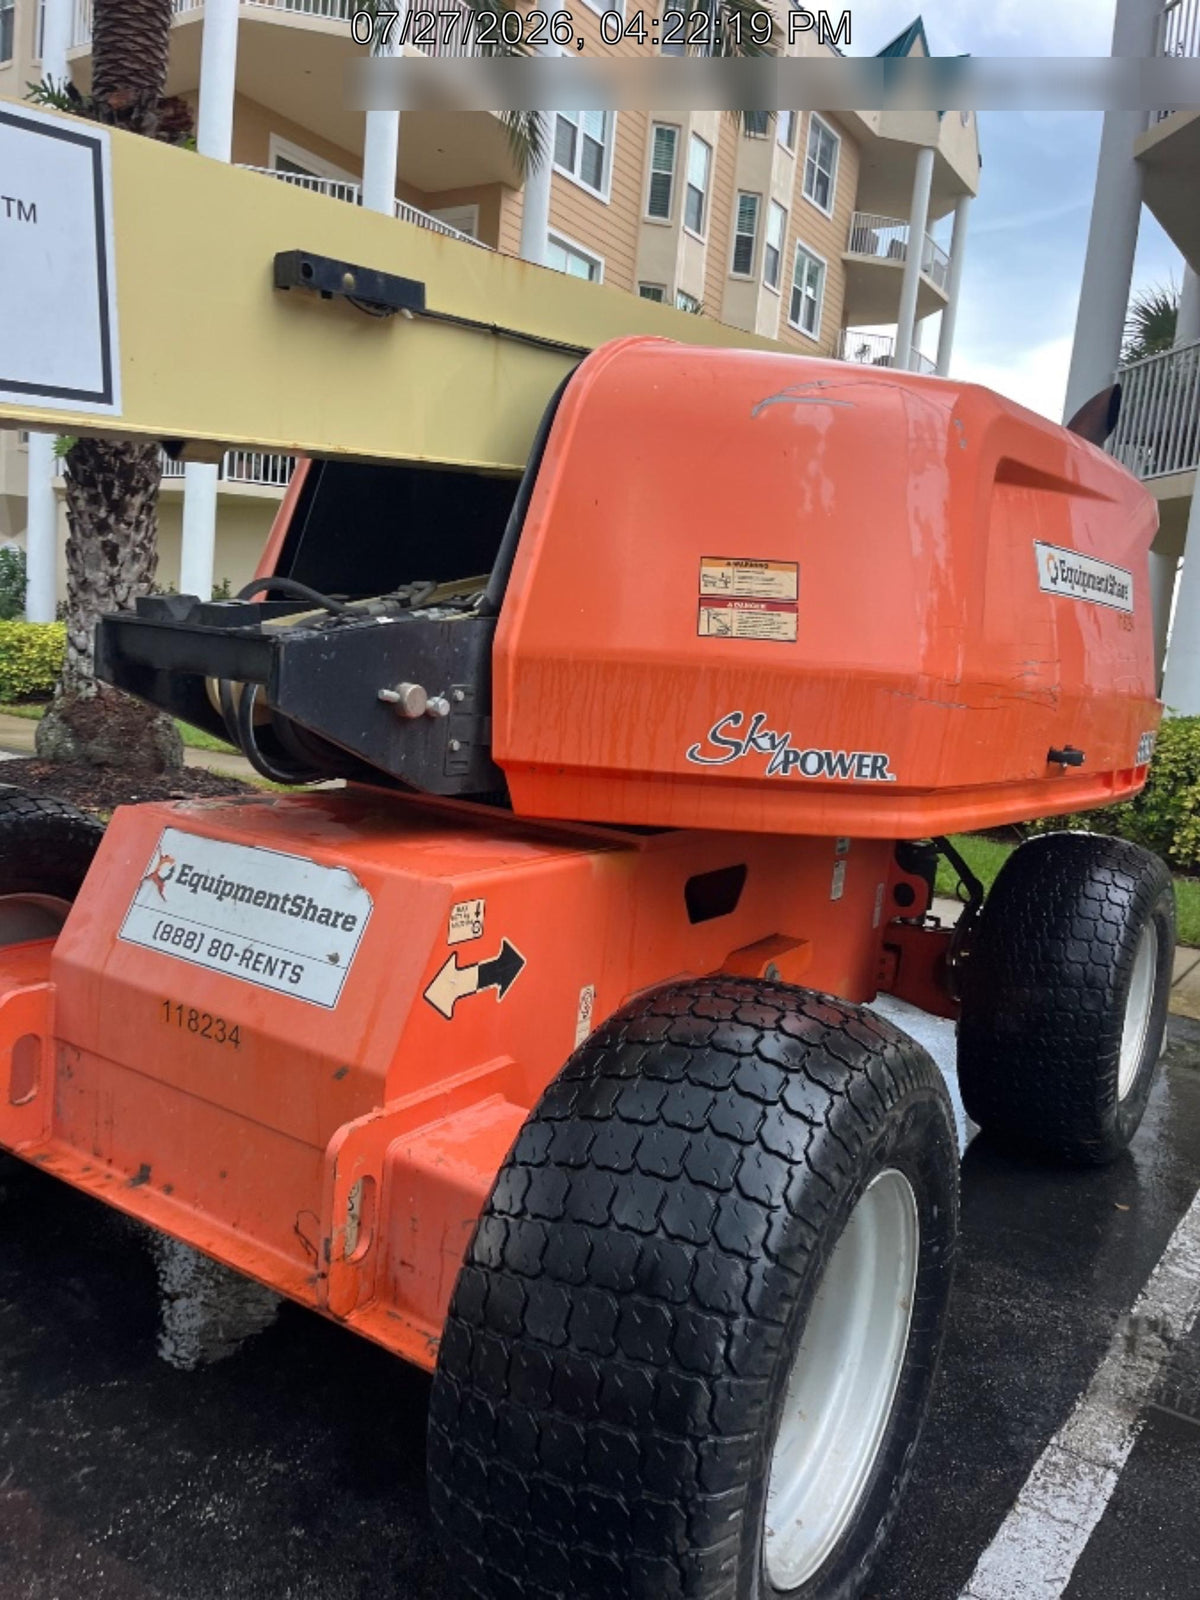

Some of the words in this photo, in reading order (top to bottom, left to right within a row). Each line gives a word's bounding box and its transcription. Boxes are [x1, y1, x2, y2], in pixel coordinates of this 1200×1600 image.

[1, 195, 37, 224] TM
[686, 710, 791, 776] Sky
[781, 748, 888, 780] POWER
[175, 862, 359, 933] EquipmentShare
[152, 920, 205, 953] (888)
[207, 938, 304, 984] 80-RENTS
[162, 1000, 241, 1049] 118234
